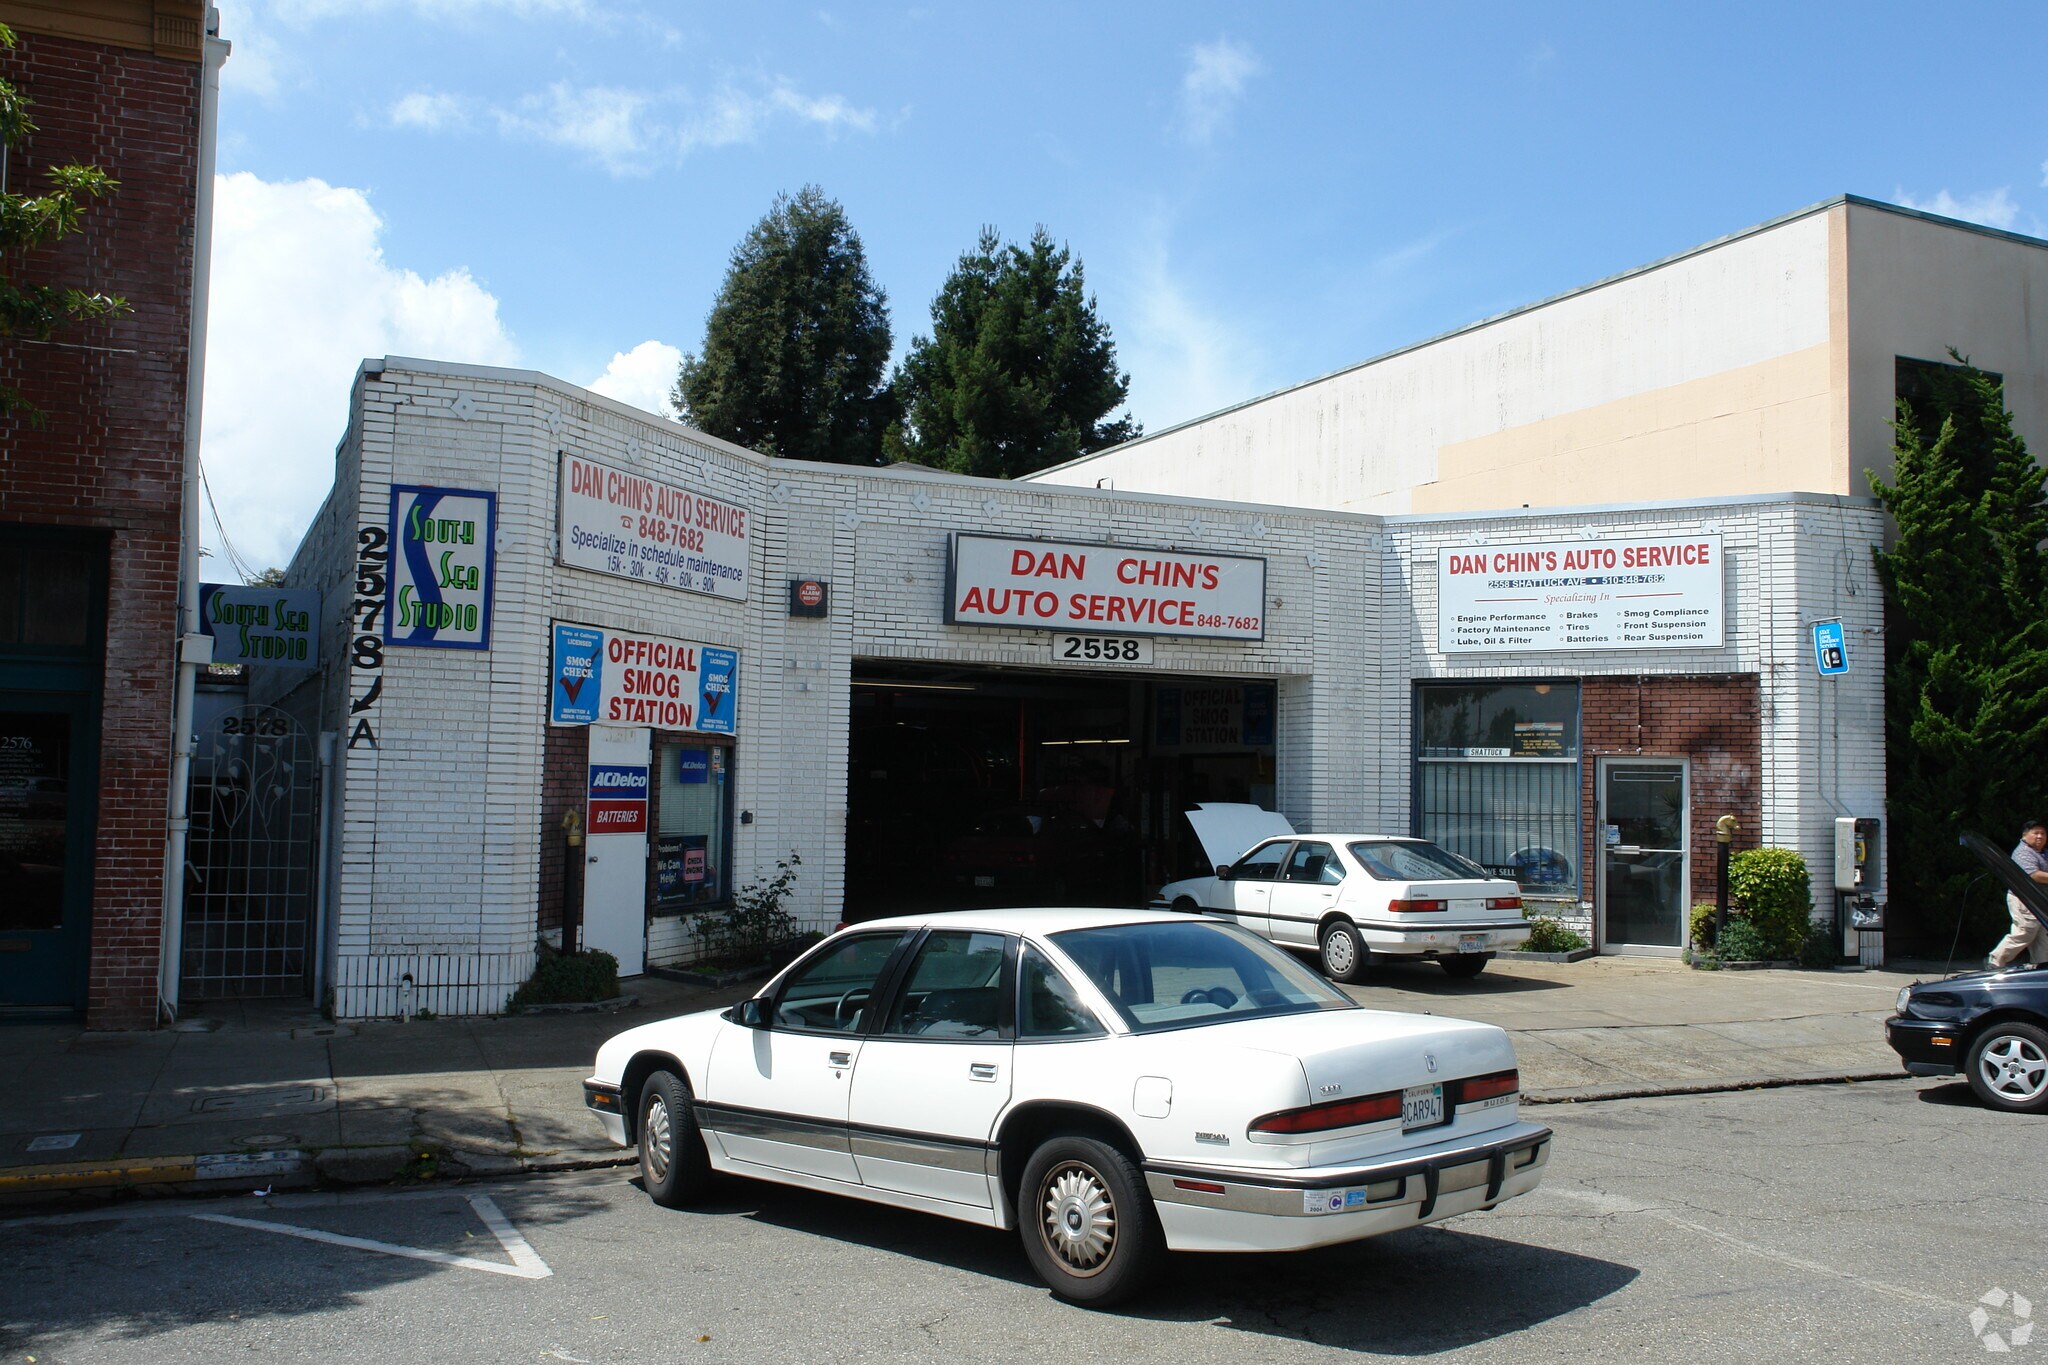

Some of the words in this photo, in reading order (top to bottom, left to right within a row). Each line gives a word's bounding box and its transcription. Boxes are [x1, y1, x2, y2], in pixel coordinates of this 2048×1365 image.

[572, 460, 603, 500] DAN
[608, 472, 653, 513] CHIN'S
[656, 486, 692, 524] AUTO
[696, 498, 745, 539] SERVICE
[638, 515, 704, 553] 848-7682
[572, 525, 626, 555] Specialize
[628, 539, 638, 557] in
[640, 544, 684, 568] schedule
[687, 557, 742, 582] maintenance
[1450, 554, 1487, 575] DAN
[1493, 551, 1557, 573] CHIN'S
[1563, 548, 1616, 570] AUTO
[1623, 544, 1710, 568] SERVICE
[608, 556, 620, 572] 15k
[630, 560, 644, 577] 30k
[655, 566, 669, 583] 45k
[680, 571, 692, 588] 60k
[702, 576, 716, 592] 90k
[1011, 549, 1086, 580] DAN
[1116, 558, 1220, 590] CHIN'S
[1489, 580, 1510, 588] 2558
[1512, 579, 1565, 588] SHATTUCK
[1567, 577, 1586, 586] AVE
[1602, 575, 1665, 584] 510-848-7682
[351, 526, 388, 670] 2578
[1544, 593, 1596, 604] Specializing
[1600, 593, 1610, 601] In
[959, 586, 1058, 618] AUTO
[1068, 593, 1196, 626] SERVICE
[1197, 614, 1259, 630] 848-7682
[1653, 608, 1709, 616] Compliance
[1457, 615, 1487, 623] Engine
[1652, 621, 1706, 630] Suspension
[1493, 625, 1550, 633] Maintenance
[1457, 638, 1481, 646] Lube,
[1484, 637, 1496, 645] Oil
[1649, 633, 1703, 642] Suspension
[608, 638, 697, 672] OFFICIAL
[1063, 637, 1140, 661] 2558
[566, 656, 592, 667] SMOG
[563, 667, 594, 678] CHECK
[708, 674, 728, 684] SMOG
[623, 668, 680, 698] SMOG
[705, 683, 730, 693] CHECK
[1184, 688, 1242, 706] OFFICIAL
[608, 697, 692, 727] STATION
[1192, 707, 1229, 724] SMOG
[222, 716, 288, 736] 2578
[348, 718, 378, 750] A
[1185, 728, 1238, 744] STATION
[1, 736, 32, 749] 2576
[592, 772, 647, 787] ACDelco
[597, 811, 638, 823] BATTERIES
[1498, 868, 1516, 876] SELL
[1408, 1088, 1433, 1098] CALIFORNIA
[1484, 1096, 1510, 1107] BUICK
